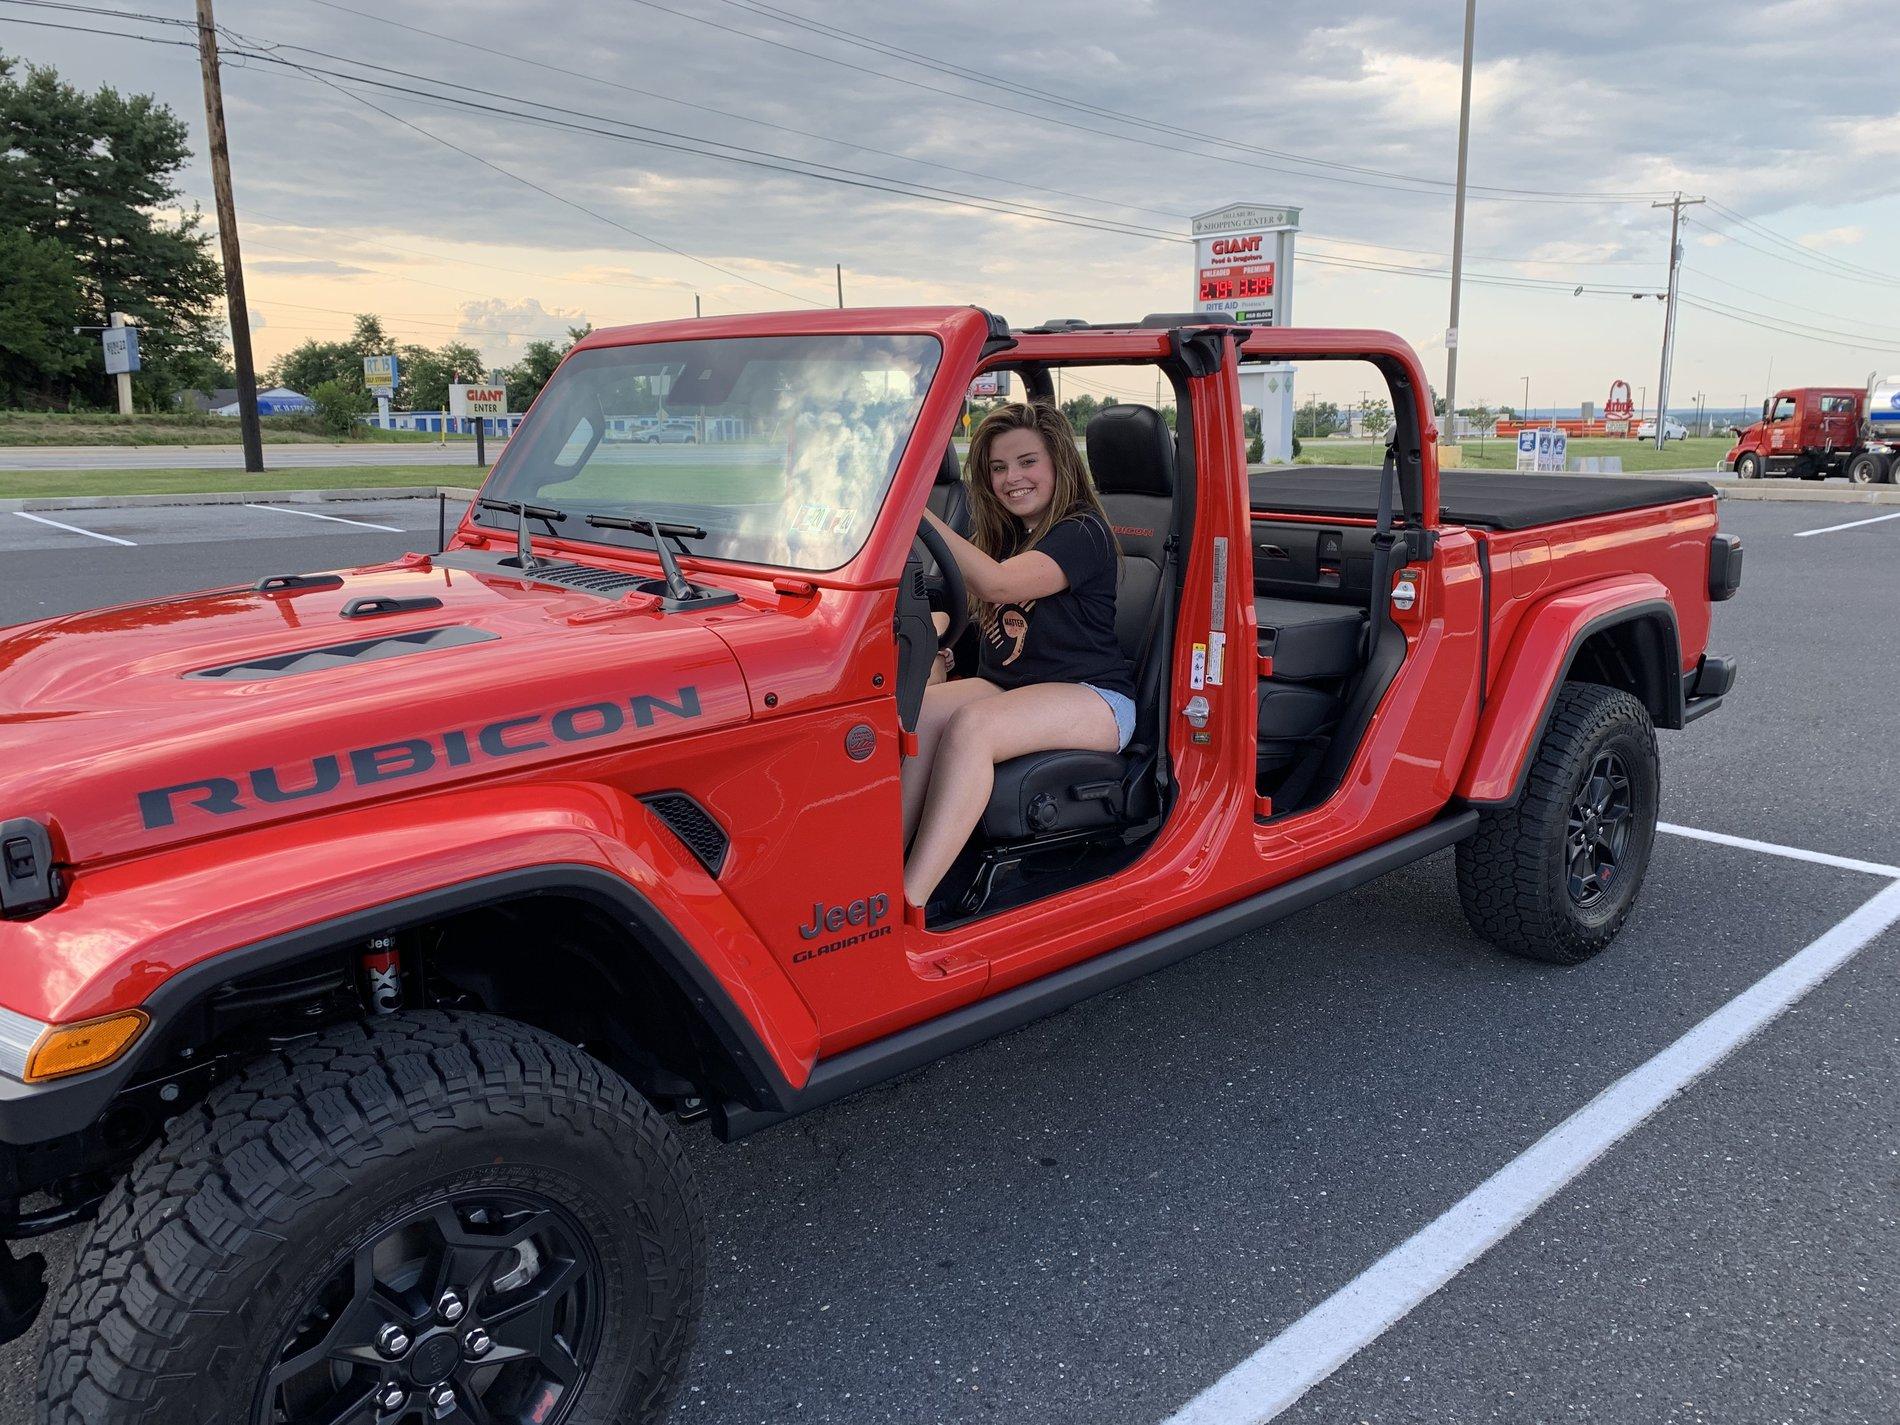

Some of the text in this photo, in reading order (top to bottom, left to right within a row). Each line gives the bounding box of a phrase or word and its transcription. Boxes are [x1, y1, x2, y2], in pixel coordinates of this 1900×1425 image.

[1204, 217, 1274, 230] SHOPPING CENTER
[1212, 236, 1263, 255] GIANT
[1203, 265, 1270, 277] UNLEADED PREMIUM
[1206, 302, 1223, 311] RITE
[1225, 301, 1239, 310] AID
[381, 356, 391, 370] 15
[466, 389, 504, 402] GIANT
[474, 403, 498, 413] ENTER
[137, 686, 703, 831] RUBICON
[800, 892, 889, 940] Jeep
[368, 937, 395, 949] Jeep
[793, 926, 892, 963] GLADIATOR
